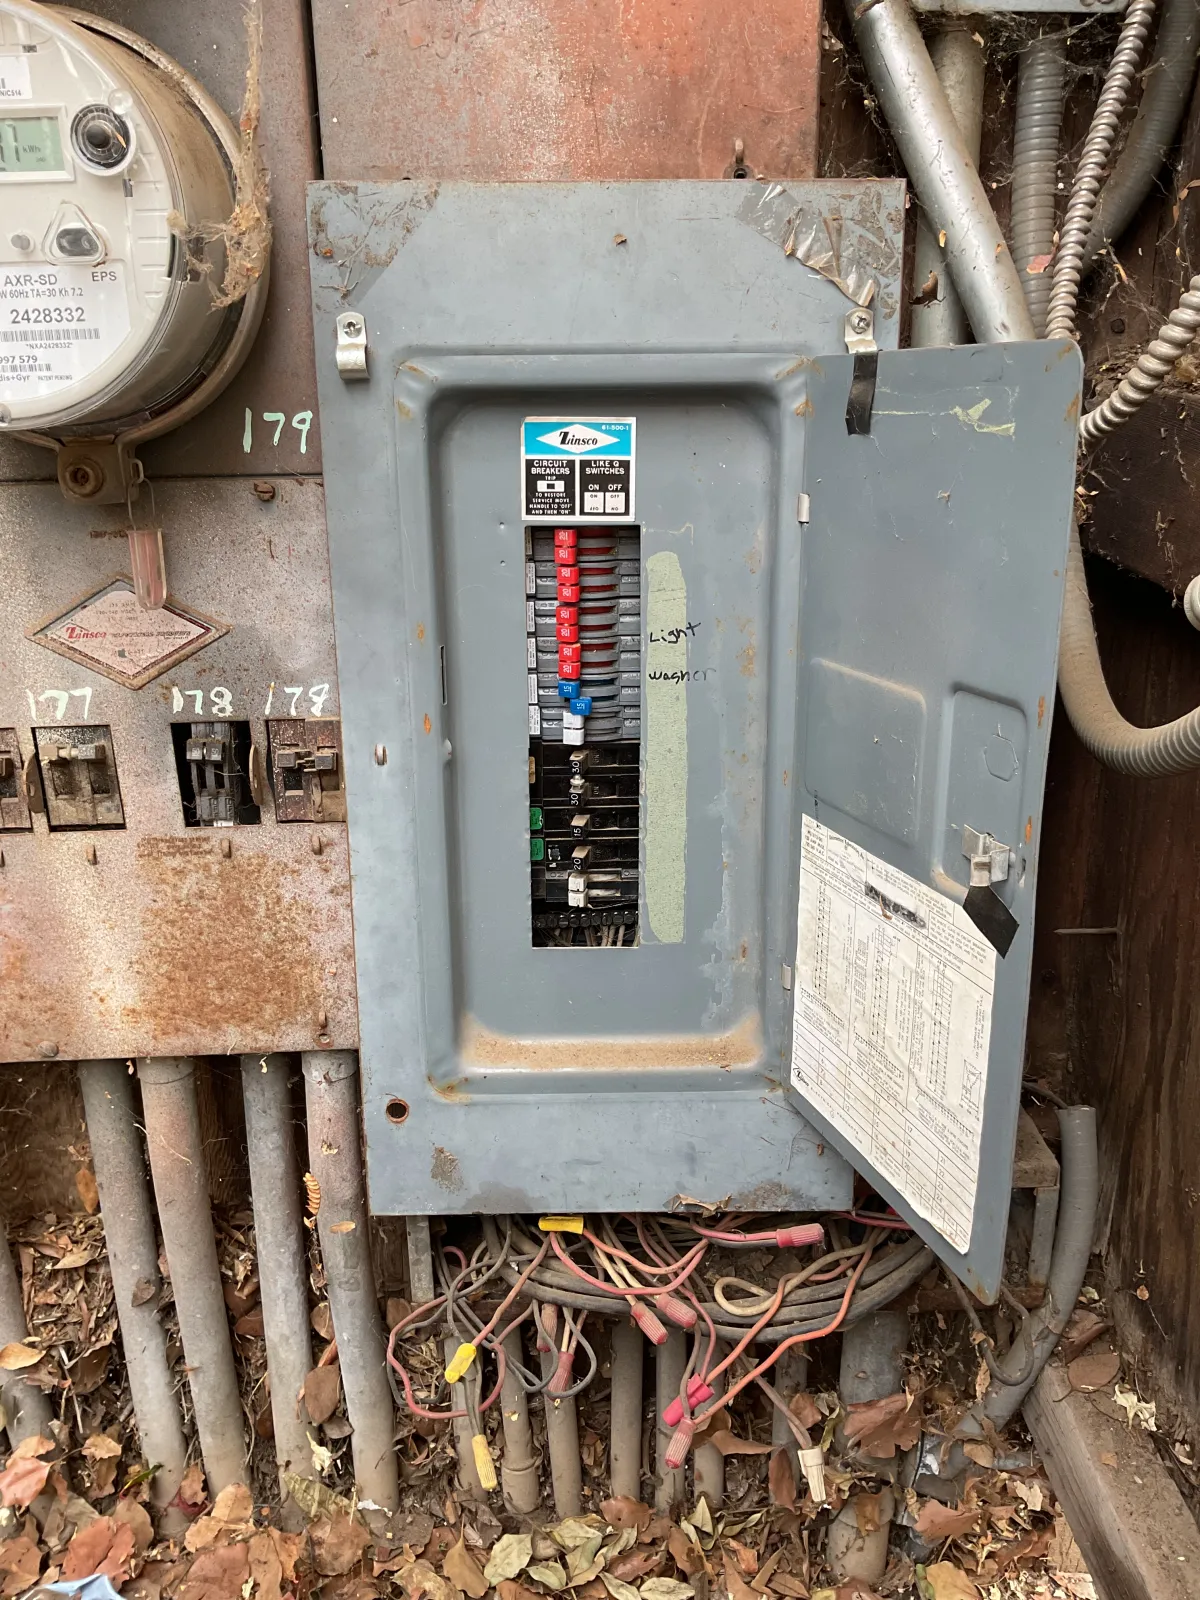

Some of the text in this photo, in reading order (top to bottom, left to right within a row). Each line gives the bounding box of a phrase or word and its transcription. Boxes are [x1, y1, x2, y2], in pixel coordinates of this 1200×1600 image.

[4, 273, 58, 287] AXR-SD
[91, 271, 117, 282] EPS
[9, 289, 29, 299] 60Hz
[30, 288, 57, 299] TA=30
[59, 287, 69, 298] Kh
[71, 287, 84, 297] 7.2
[9, 306, 86, 324] 2428332
[19, 355, 38, 364] 579
[242, 408, 314, 455] 179
[558, 431, 599, 446] Zinsco
[531, 467, 571, 475] BREAKERS
[585, 467, 625, 475] SWITCHES
[559, 530, 568, 541] 20
[559, 549, 568, 559] 20
[561, 568, 570, 578] 20
[562, 588, 571, 597] 20
[560, 610, 569, 620] 20
[64, 625, 108, 640] Zinsco
[561, 628, 570, 637] 20
[649, 621, 702, 644] Light
[563, 649, 572, 657] 20
[563, 665, 572, 674] 20
[563, 685, 572, 694] 15
[25, 686, 93, 721] 177
[171, 685, 234, 718] 178
[576, 702, 585, 711] 15
[572, 761, 581, 774] 30
[570, 793, 579, 806] 30
[574, 827, 582, 837] 15
[573, 858, 582, 871] 20
